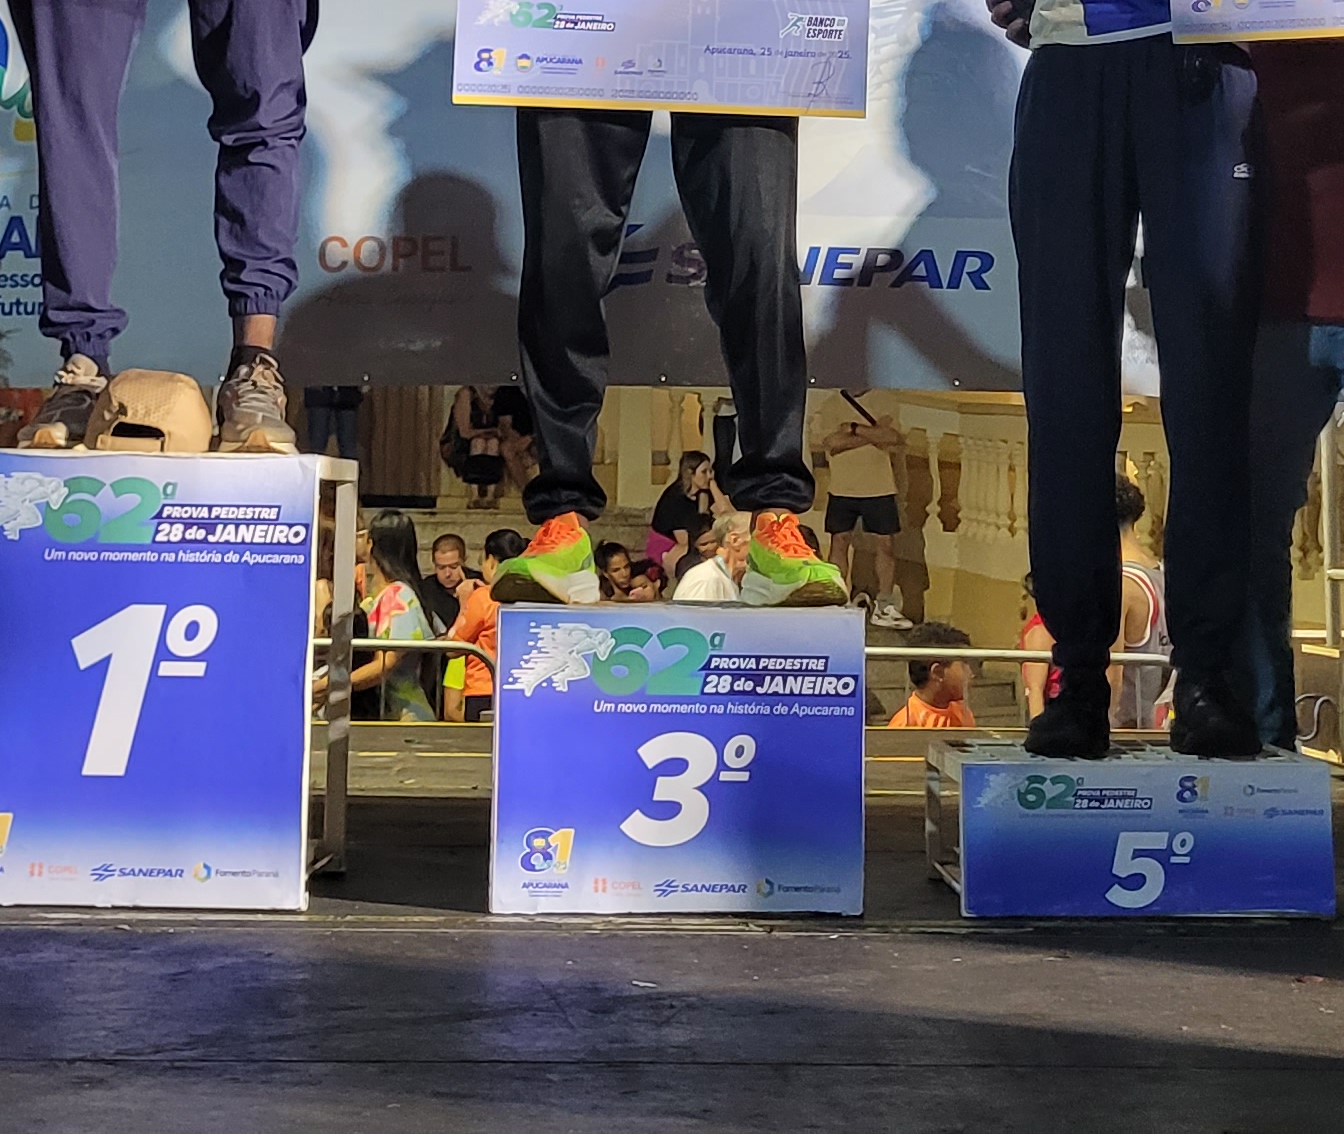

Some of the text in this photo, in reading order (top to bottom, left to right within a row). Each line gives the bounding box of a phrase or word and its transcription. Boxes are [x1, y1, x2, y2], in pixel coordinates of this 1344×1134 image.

[553, 21, 614, 31] 28 JANEIRO
[806, 16, 836, 27] BANCO
[806, 28, 844, 40] ESPORTE
[704, 44, 816, 59] Apucarana, 25 janeiro
[473, 48, 507, 74] 81
[535, 55, 583, 66] APUCARANA
[29, 194, 40, 210] D
[318, 235, 473, 273] COPEL
[666, 242, 994, 291] SNEPAR
[44, 475, 178, 545] 62ª
[162, 506, 279, 520] PROVA PEDESTRE
[155, 523, 307, 545] 28 de JANEIRO
[44, 547, 305, 566] Um novo momento na história de Apucarana
[591, 626, 726, 695] 62ª
[710, 657, 825, 671] PROVA PEDESTRE
[70, 603, 219, 777] 1º
[704, 673, 855, 695] 28 de JANEIRO
[594, 699, 855, 719] Um novo momento na história de Apucarana
[619, 730, 757, 848] 3º
[1017, 774, 1085, 810] 62ª
[1076, 788, 1101, 797] PROVA
[1176, 775, 1210, 804] 81
[1074, 798, 1151, 810] 28 JANEIRO
[519, 826, 575, 875] 81
[47, 865, 78, 876] COPEL
[117, 866, 185, 879] SANEPAR
[1105, 831, 1195, 909] 5º
[521, 881, 570, 890] APUCARANA
[611, 881, 643, 891] COPEL
[680, 882, 748, 895] SANEPAR
